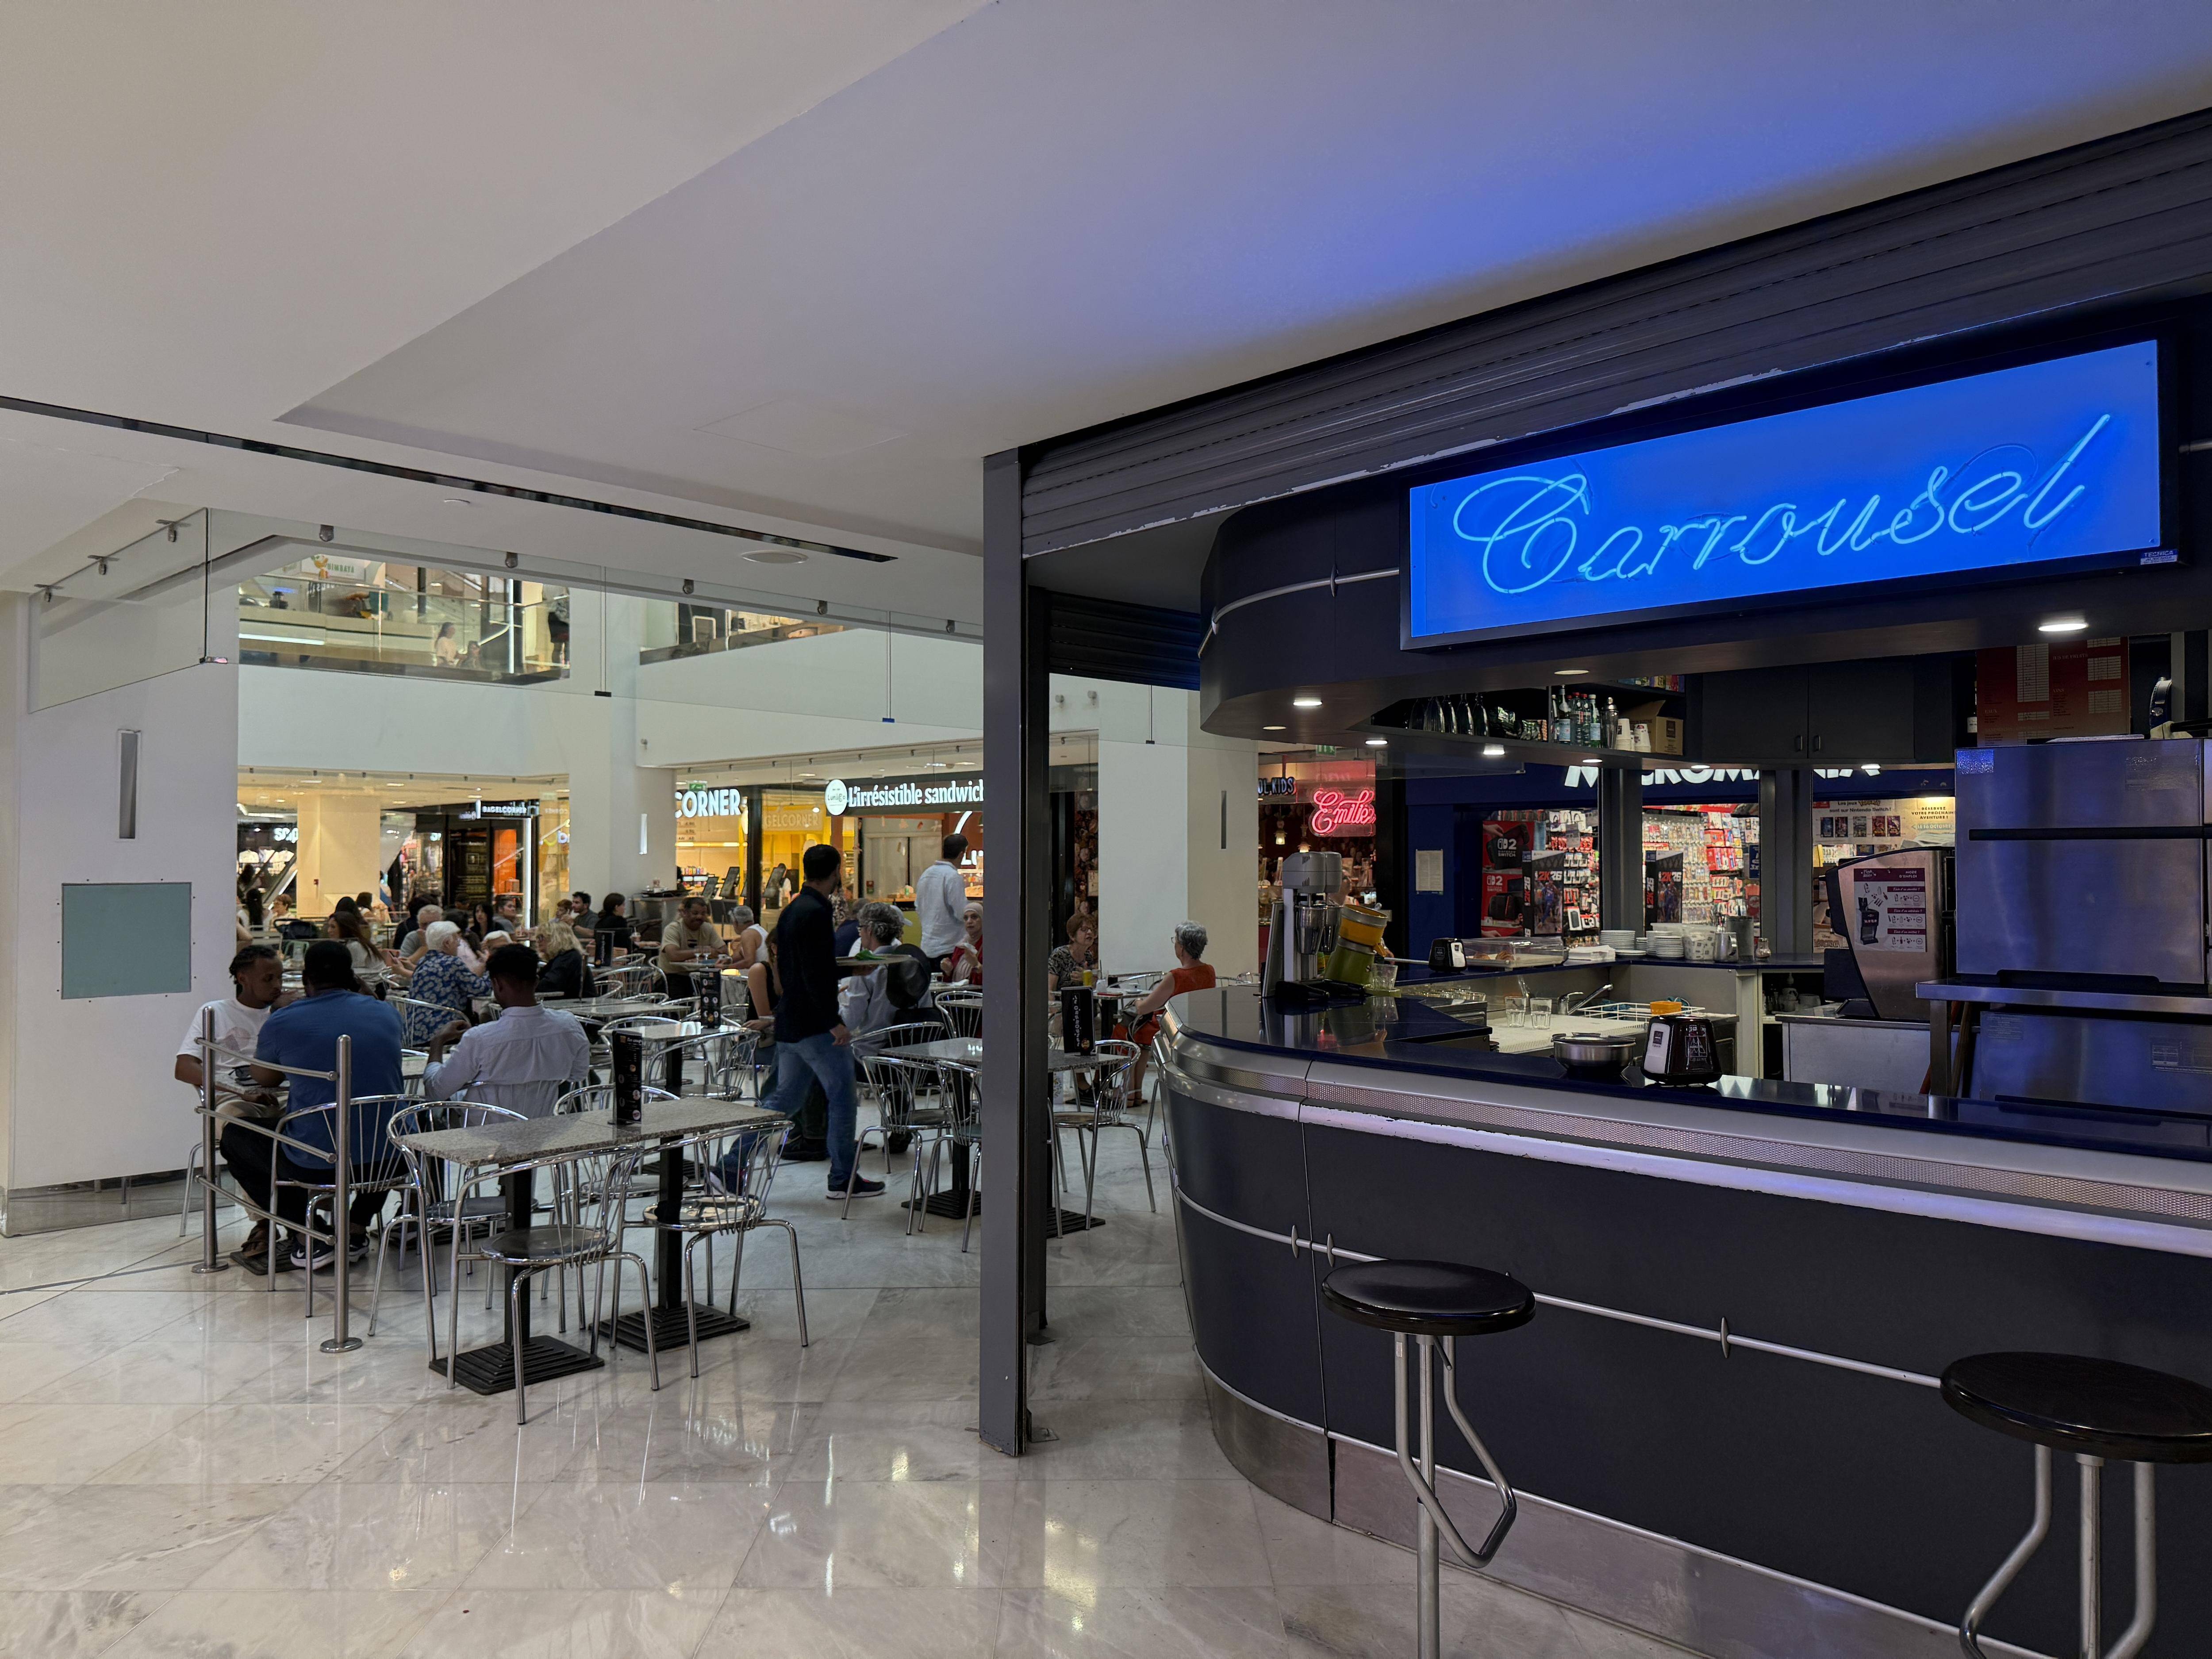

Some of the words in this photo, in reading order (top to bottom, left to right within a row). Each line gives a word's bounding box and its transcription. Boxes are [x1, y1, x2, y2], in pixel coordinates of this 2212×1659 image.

[1452, 414, 2111, 594] Carrousel
[848, 783, 922, 807] L'irrésistible
[1272, 777, 1294, 794] KIDS
